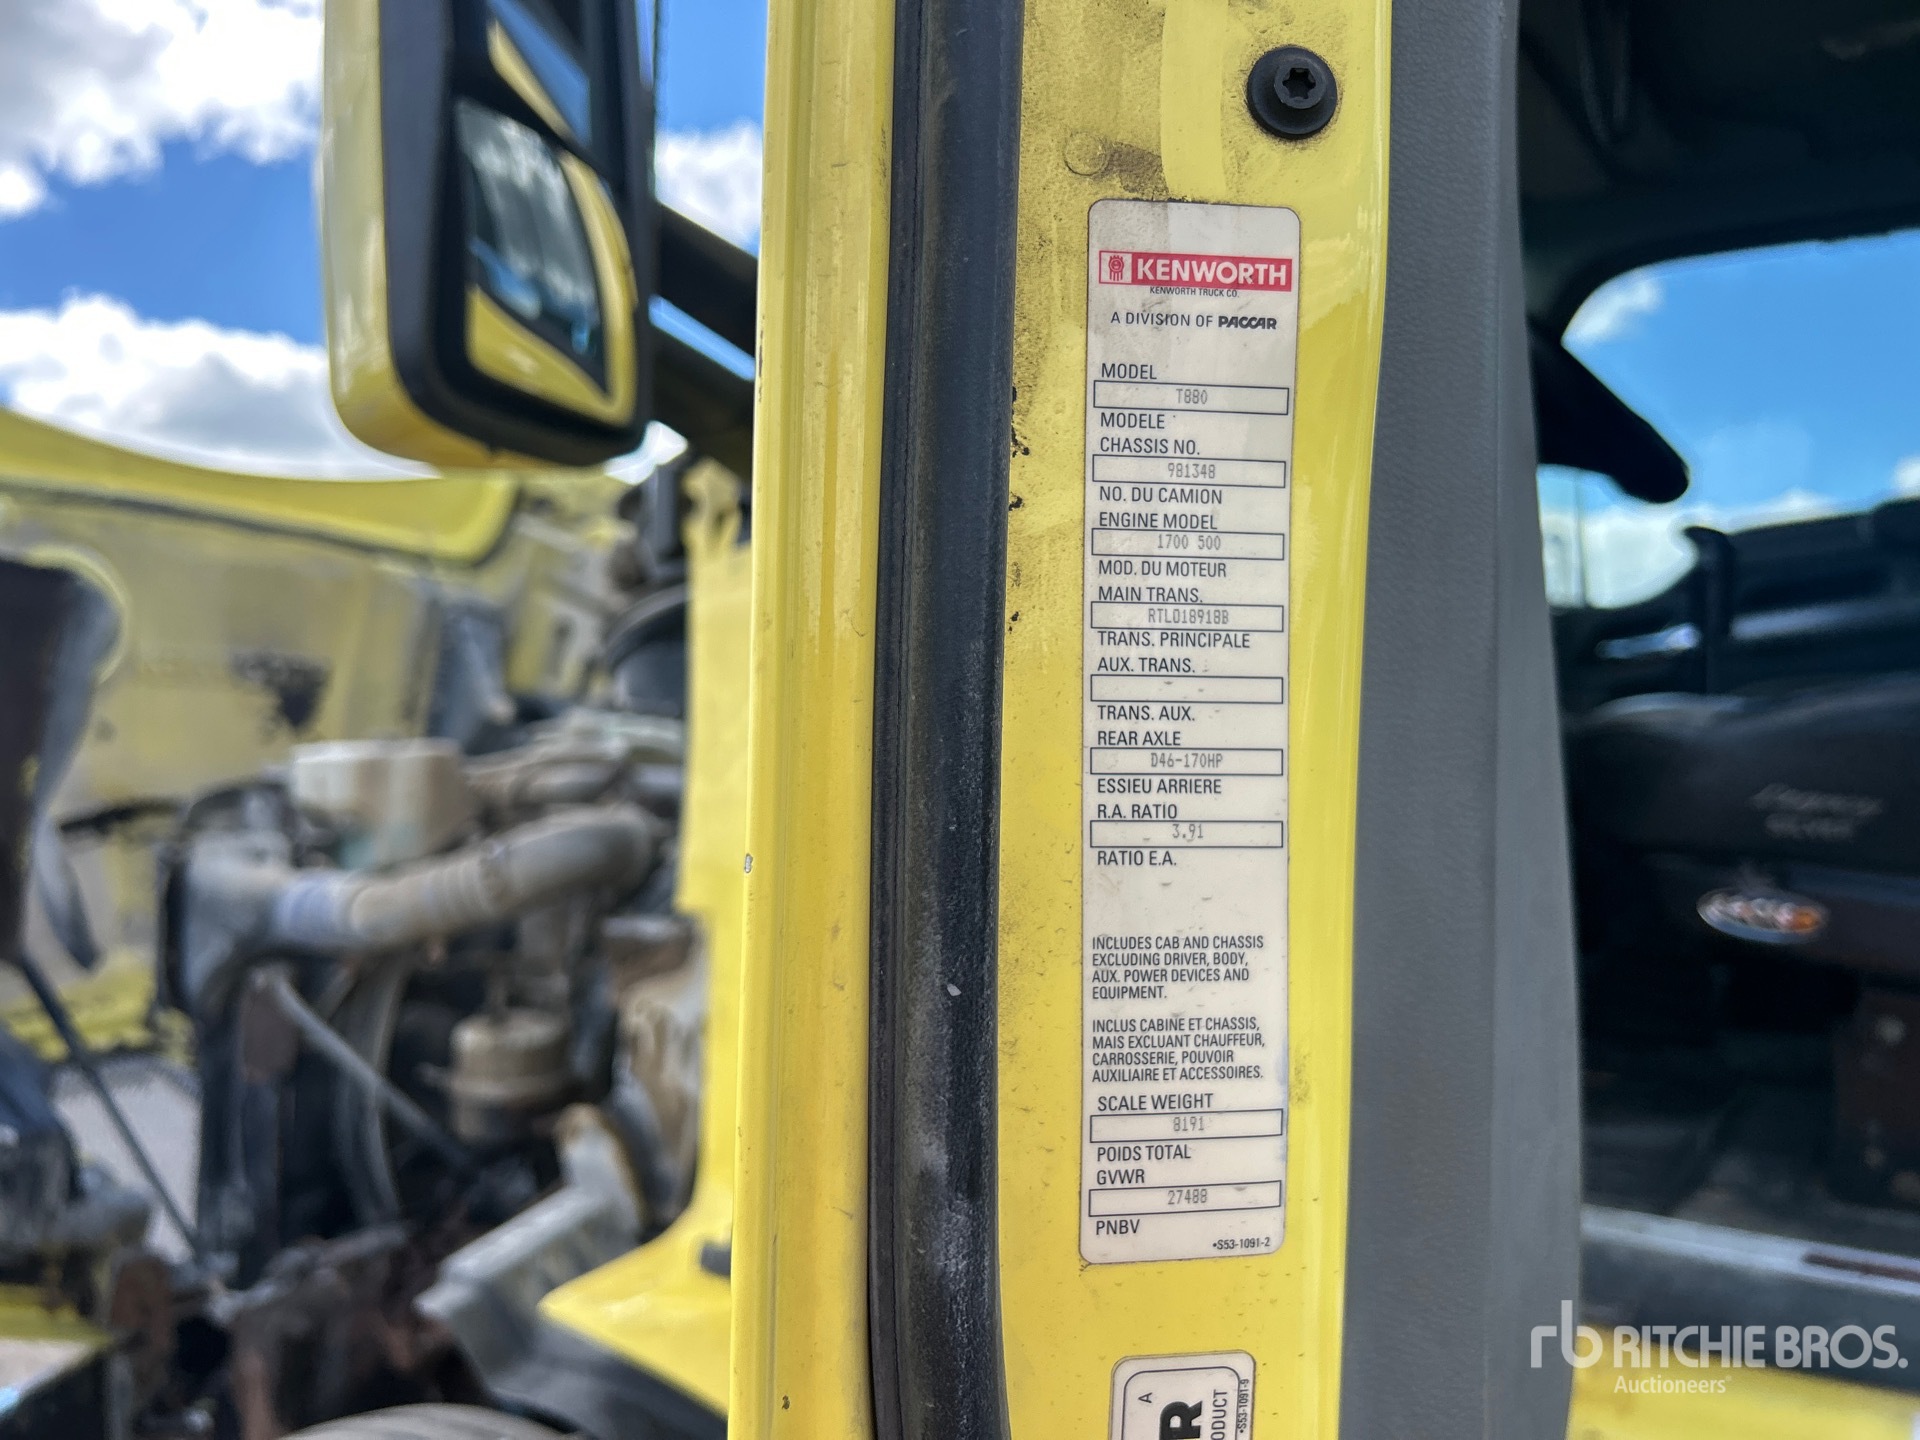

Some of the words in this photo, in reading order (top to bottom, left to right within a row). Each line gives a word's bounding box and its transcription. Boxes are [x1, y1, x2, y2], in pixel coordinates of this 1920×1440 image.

[1137, 258, 1286, 286] KENWORTH
[1150, 287, 1196, 296] KENWORTH
[1199, 288, 1224, 297] TRUCK
[1227, 289, 1239, 298] CO.
[1111, 312, 1120, 324] A
[1126, 312, 1190, 326] DIVISION
[1196, 315, 1212, 327] OF
[1218, 316, 1277, 329] PACCAR
[1101, 363, 1157, 380] MODEL
[1176, 389, 1208, 404] T880
[1100, 413, 1165, 429] MODELE
[1100, 438, 1168, 453] CHASSIS
[1174, 440, 1200, 455] NO.
[1168, 463, 1216, 478] 981348
[1100, 486, 1126, 501] NO.
[1132, 487, 1152, 502] DU
[1159, 488, 1222, 504] CAMION
[1100, 512, 1158, 528] ENGINE
[1163, 514, 1217, 529] MODEL
[1099, 560, 1137, 575] MOD.
[1142, 562, 1161, 576] DU
[1166, 562, 1226, 577] MOTEUR
[1099, 587, 1140, 601] MAIN
[1146, 588, 1203, 602] TRANS.
[1098, 631, 1154, 646] TRANS.
[1160, 632, 1250, 648] PRINCIPALE
[1097, 657, 1134, 672] AUX.
[1139, 658, 1195, 673] TRANS.
[1098, 705, 1154, 720] TRANS.
[1159, 706, 1195, 721] AUX.
[1098, 731, 1138, 746] REAR
[1143, 732, 1181, 746] AXLE
[1151, 753, 1222, 768] D46-170HP
[1098, 779, 1151, 793] ESSIEU
[1157, 779, 1222, 794] ARRIERE
[1098, 804, 1126, 818] R.A.
[1132, 804, 1177, 818] RATIO
[1172, 824, 1204, 839] 3.91
[1098, 851, 1143, 865] RATIO
[1149, 851, 1176, 865] E.A.
[1093, 937, 1151, 949] INCLUDES
[1155, 936, 1179, 949] CAB
[1184, 936, 1209, 949] AND
[1213, 936, 1264, 948] CHASSIS
[1093, 953, 1160, 966] EXCLUDING
[1164, 953, 1210, 966] DRIVER,
[1214, 952, 1248, 966] BODY,
[1092, 970, 1120, 982] AUX.
[1124, 970, 1167, 982] POWER
[1171, 969, 1220, 982] DEVICES
[1224, 968, 1249, 981] AND
[1093, 986, 1167, 1000] EQUIPMENT.
[1093, 1019, 1136, 1032] INCLUS
[1140, 1018, 1184, 1032] CABINE
[1189, 1018, 1202, 1030] ET
[1206, 1017, 1260, 1031] CHASSIS,
[1093, 1036, 1124, 1049] MAIS
[1129, 1035, 1190, 1048] EXCLUANT
[1194, 1033, 1265, 1048] CHAUFFEUR,
[1093, 1052, 1177, 1066] CARROSSERIE,
[1182, 1050, 1234, 1063] POUVOIR
[1092, 1068, 1159, 1082] AUXILIAIRE
[1163, 1068, 1176, 1080] ET
[1179, 1066, 1263, 1080] ACCESSOIRES.
[1098, 1095, 1146, 1111] SCALE
[1151, 1093, 1213, 1110] WEIGHT
[1173, 1116, 1204, 1132] 8191
[1097, 1146, 1141, 1161] POIDS
[1146, 1144, 1191, 1160] TOTAL
[1097, 1169, 1145, 1185] GVWR
[1096, 1220, 1140, 1235] PNBV
[1138, 1392, 1152, 1403] A
